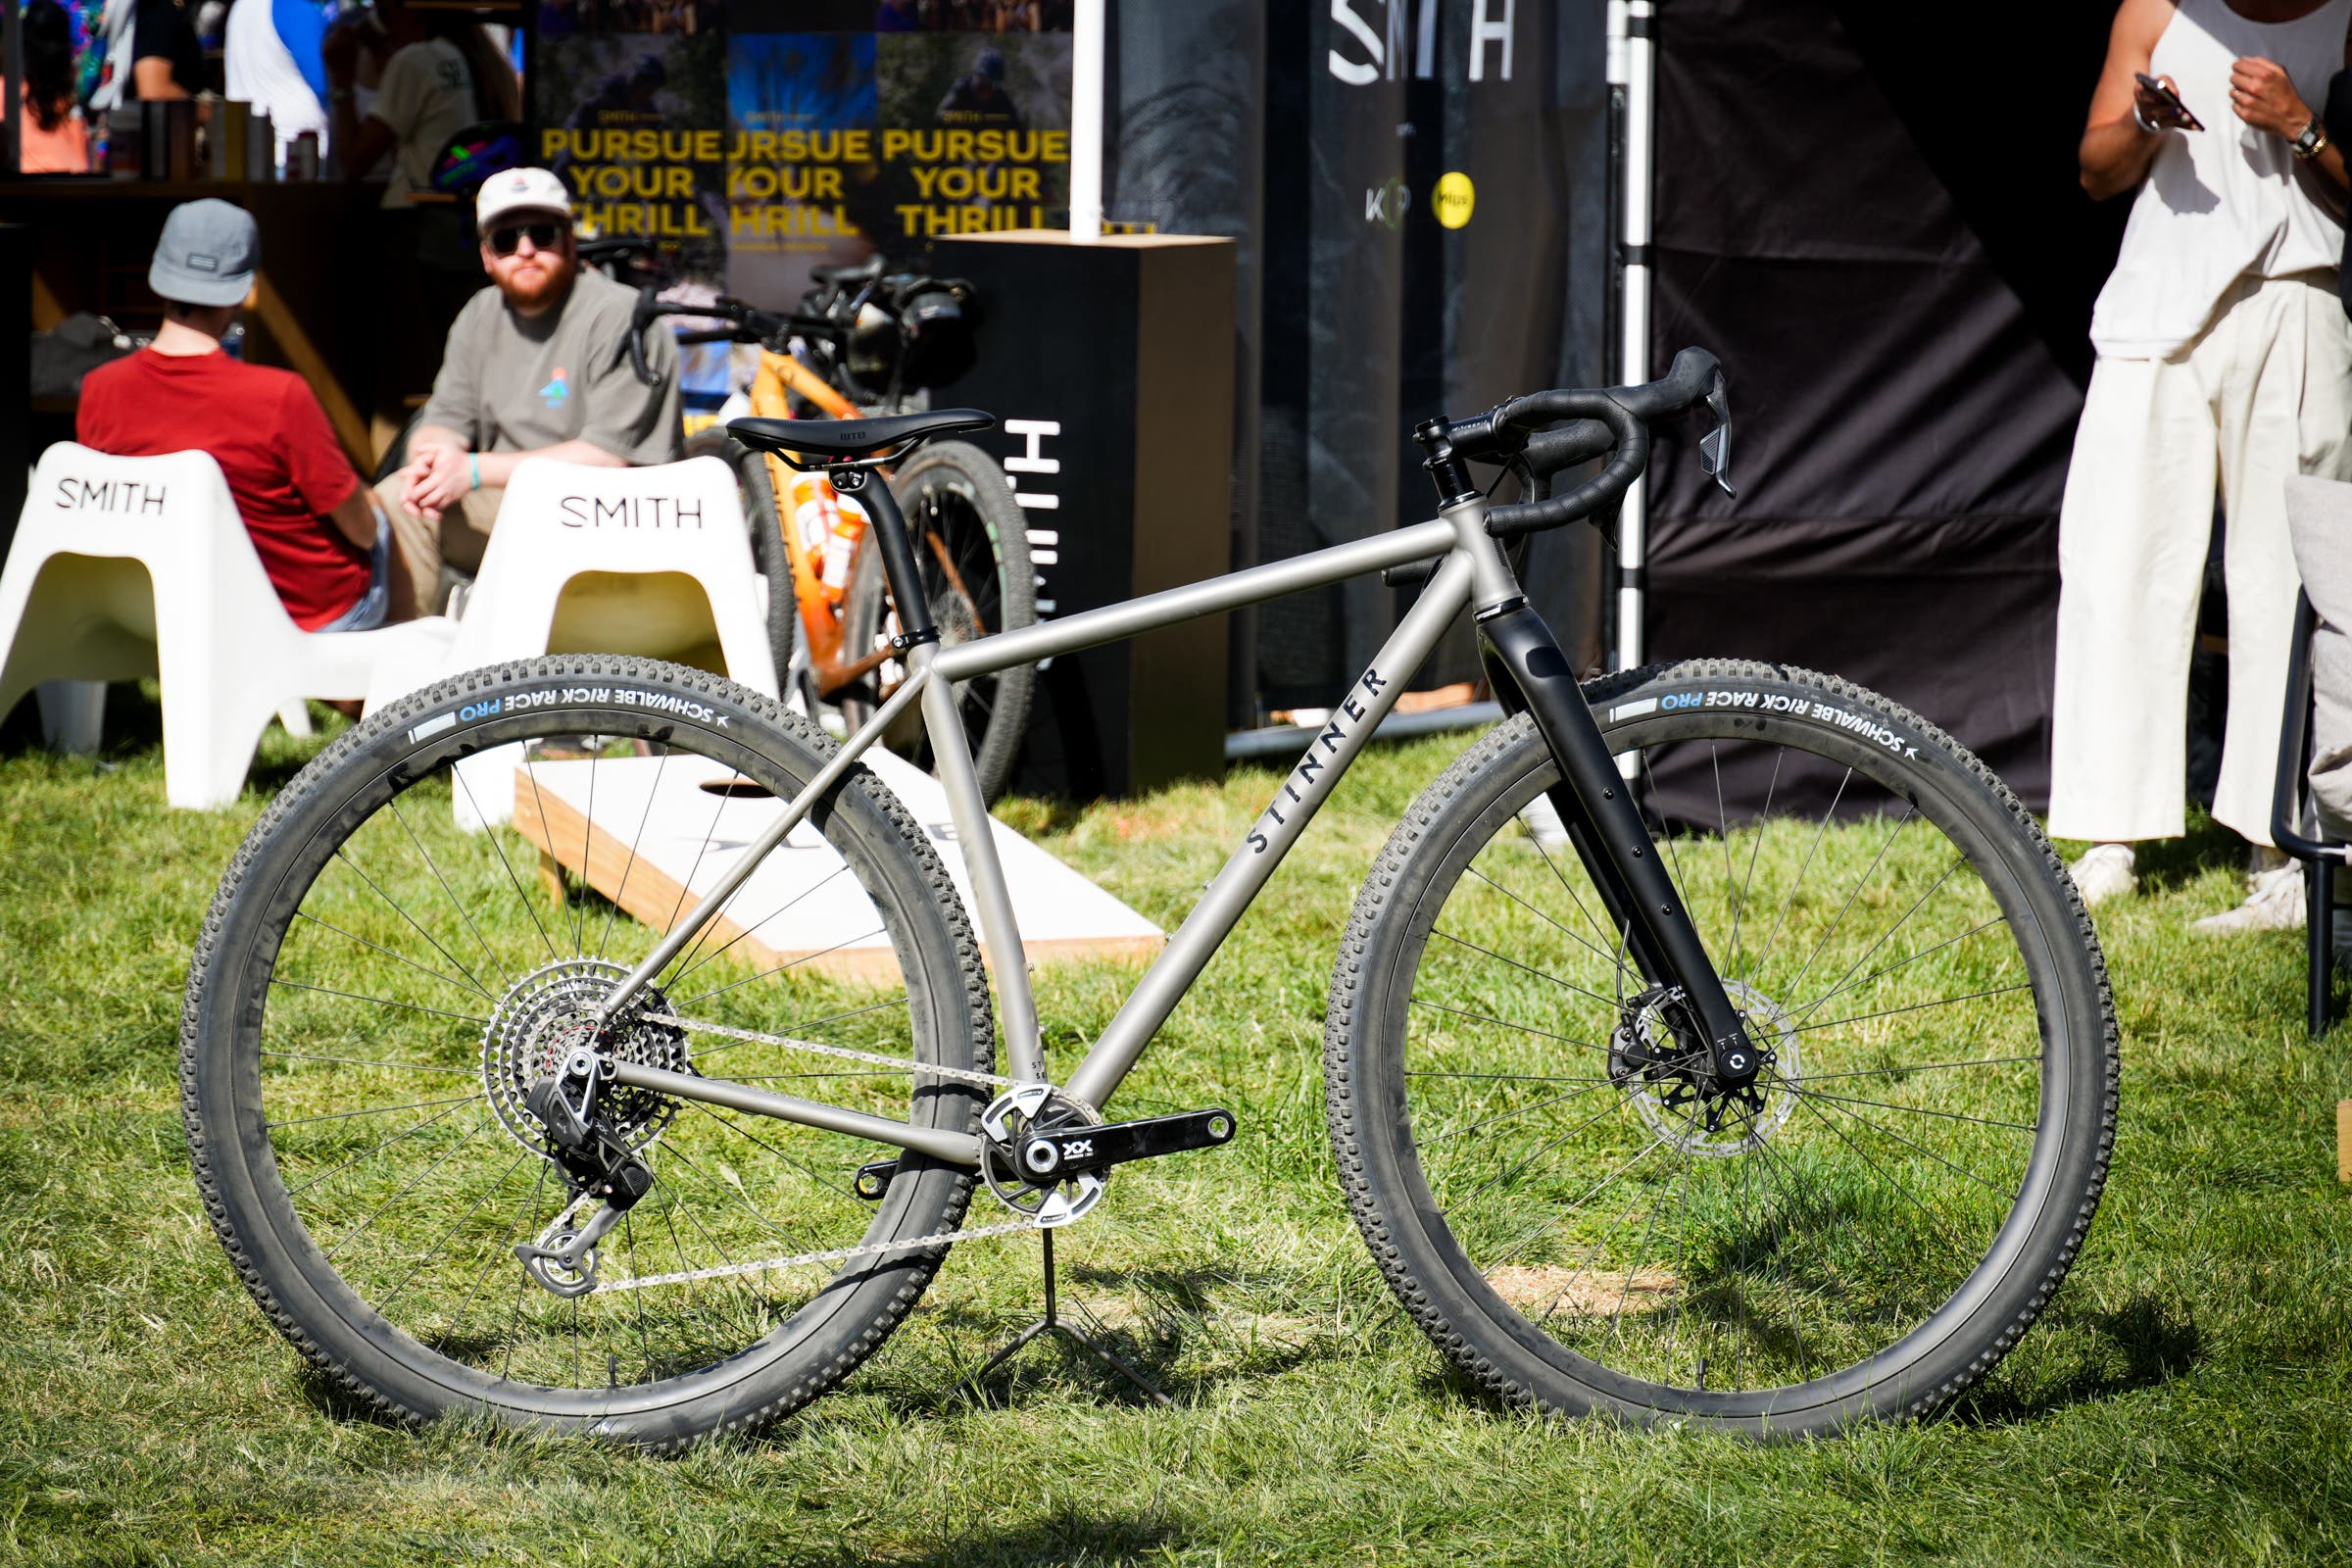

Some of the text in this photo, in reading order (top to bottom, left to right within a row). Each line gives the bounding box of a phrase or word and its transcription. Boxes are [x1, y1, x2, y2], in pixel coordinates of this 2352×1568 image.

[541, 128, 723, 162] PURSUE
[883, 128, 1069, 163] PURSUE
[568, 166, 695, 199] YOUR
[910, 167, 1042, 200] YOUR
[729, 204, 859, 236] HRILL
[56, 478, 166, 515] SMITH
[561, 496, 702, 529] SMITH
[460, 688, 714, 723] SCHWALBE RICK RACE PRO
[1661, 691, 1905, 753] SCHWALBE RICK RACE PRO
[1247, 668, 1388, 854] STINNER
[1062, 1139, 1094, 1156] XX
